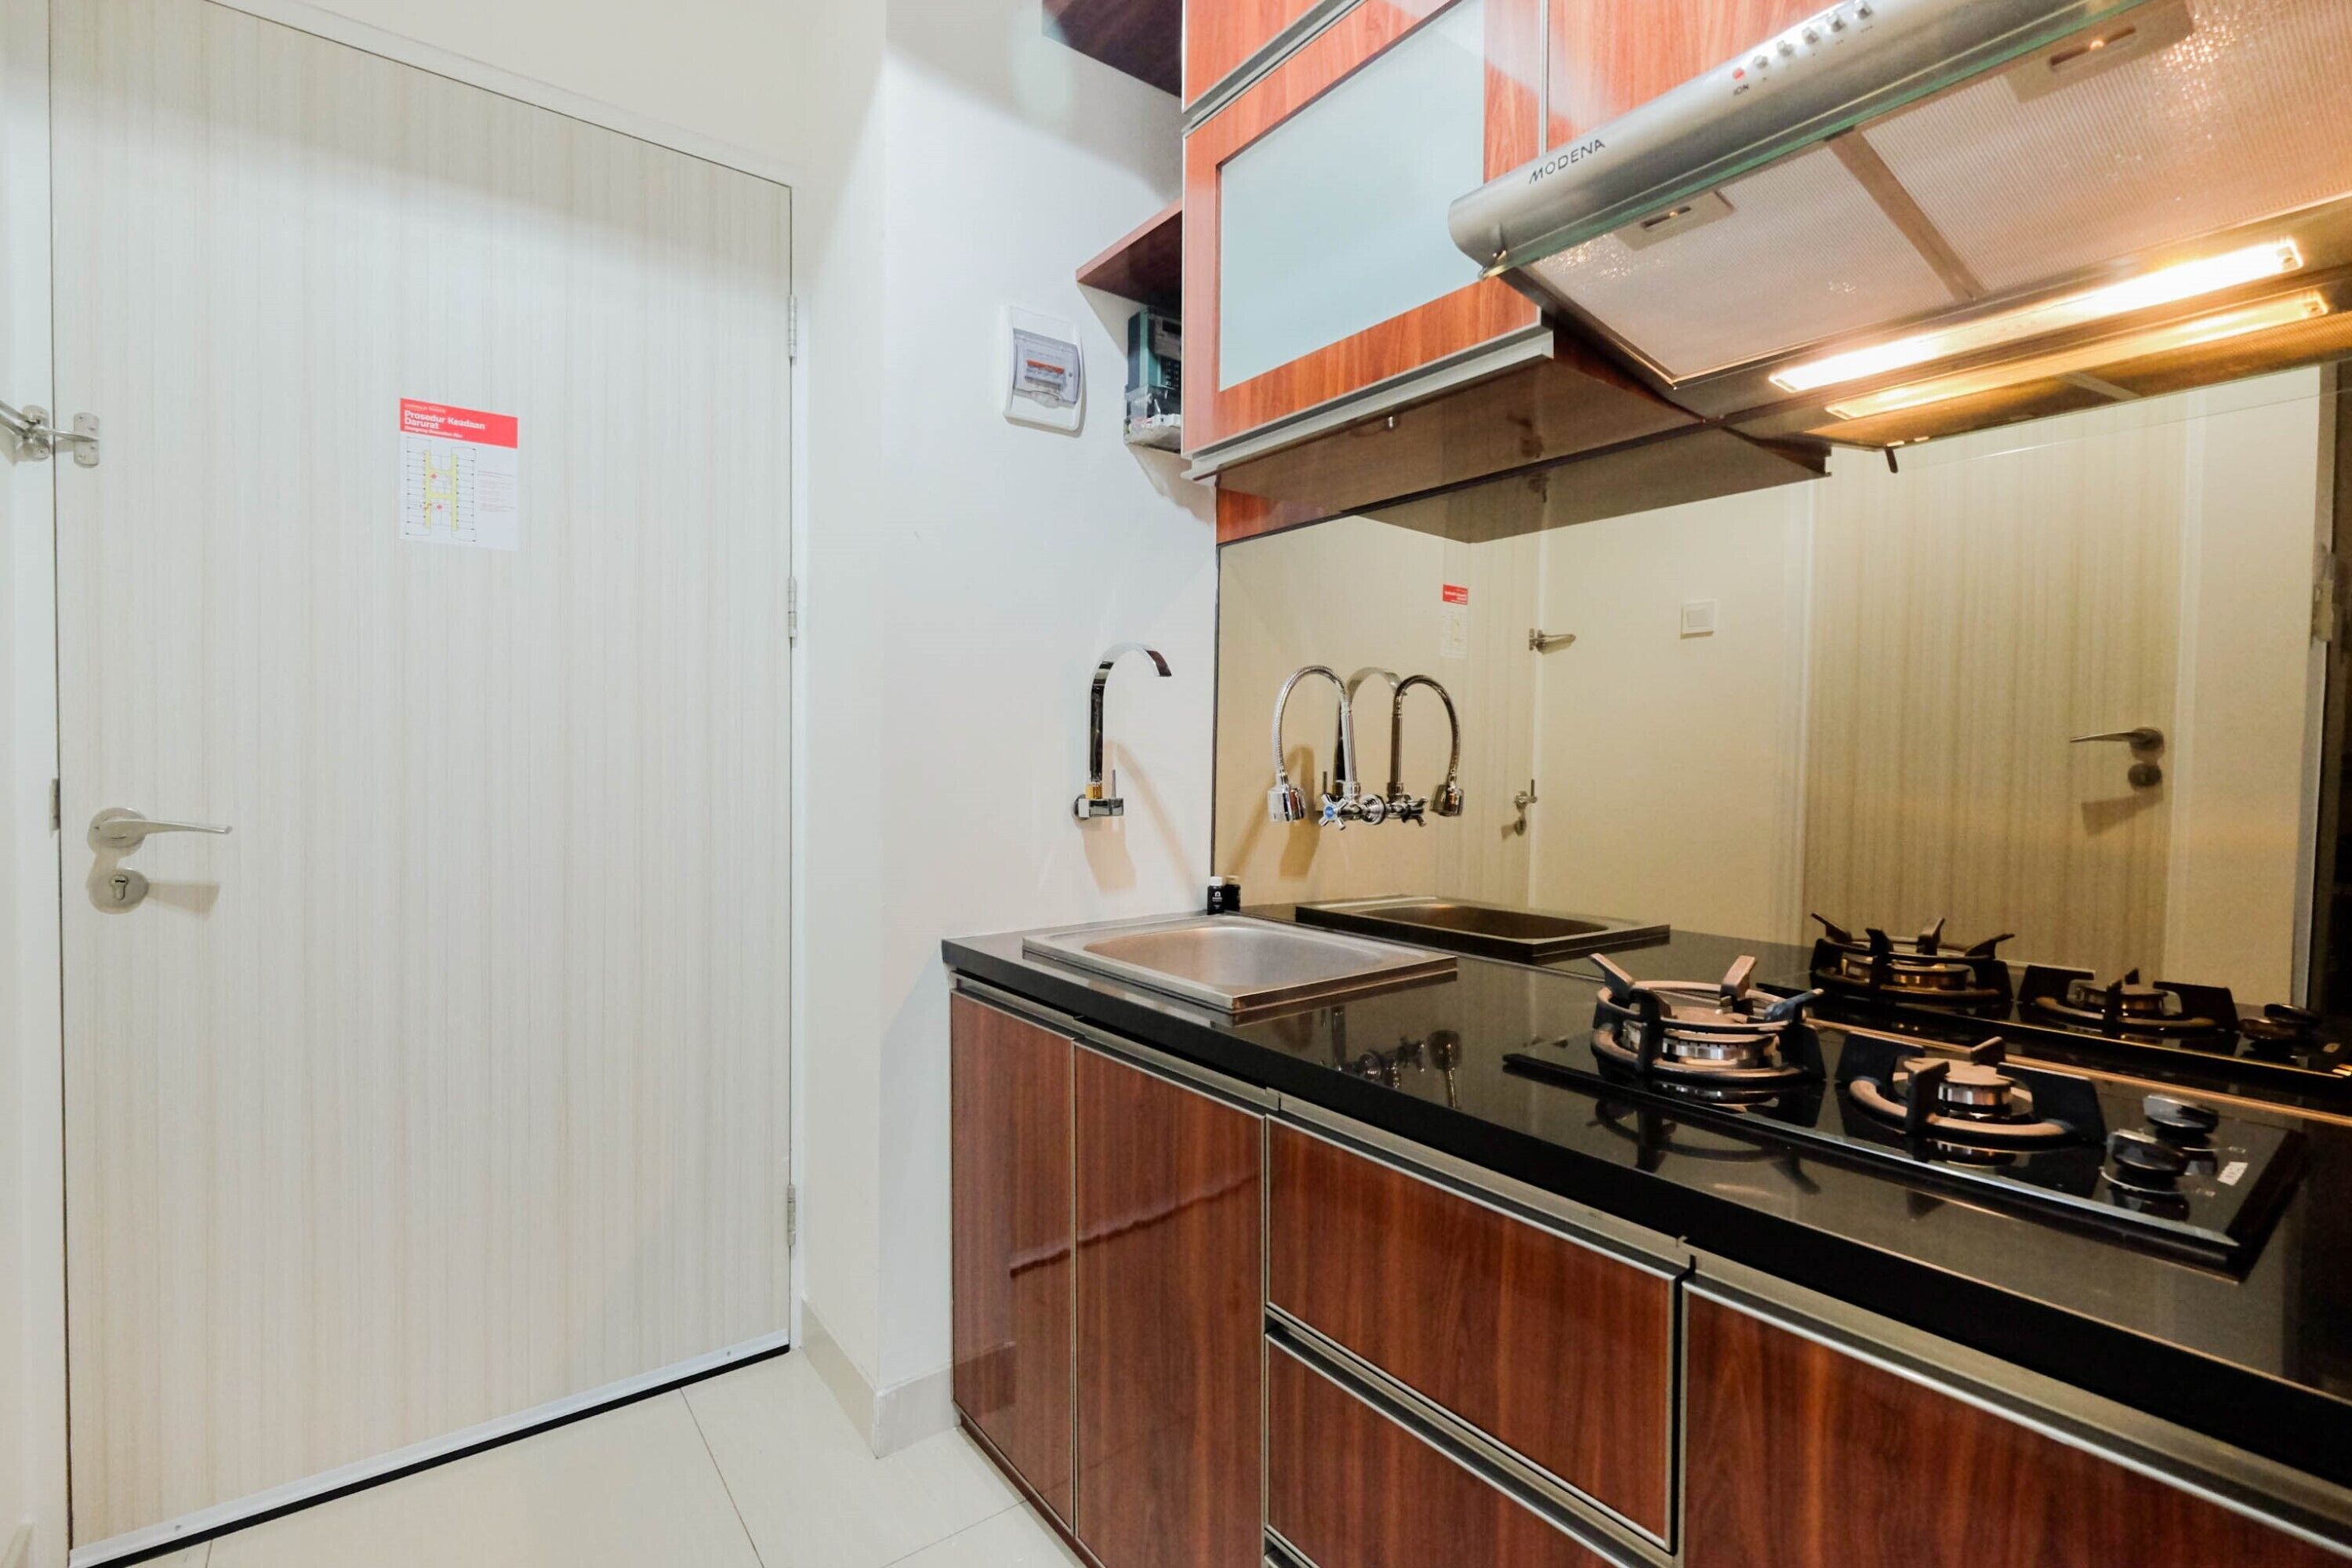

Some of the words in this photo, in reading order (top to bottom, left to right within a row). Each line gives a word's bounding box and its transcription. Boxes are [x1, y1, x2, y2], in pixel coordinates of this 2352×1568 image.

[1529, 139, 1606, 184] MODENA
[404, 410, 445, 423] Prosedur
[448, 417, 485, 430] Keadaan
[404, 418, 439, 430] Darurat
